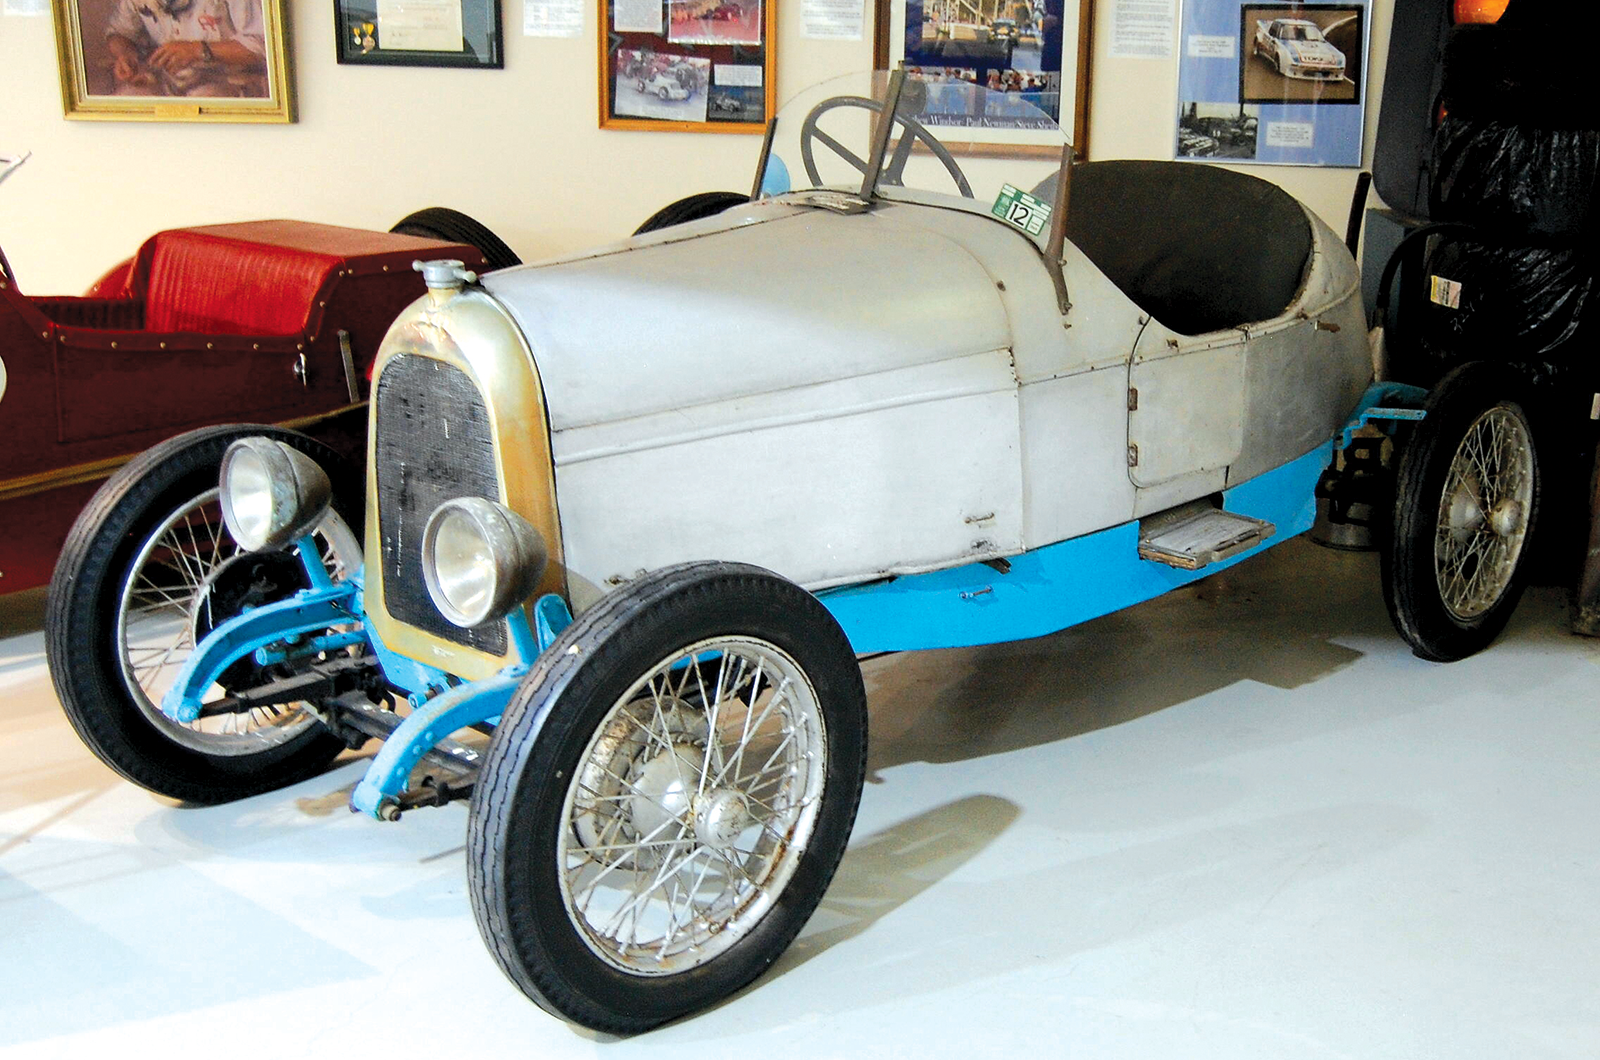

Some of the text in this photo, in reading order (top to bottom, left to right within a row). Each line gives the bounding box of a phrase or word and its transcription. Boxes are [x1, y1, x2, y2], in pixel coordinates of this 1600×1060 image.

[966, 117, 983, 128] Paul
[984, 117, 1015, 129] Newman
[1009, 203, 1029, 226] 12
